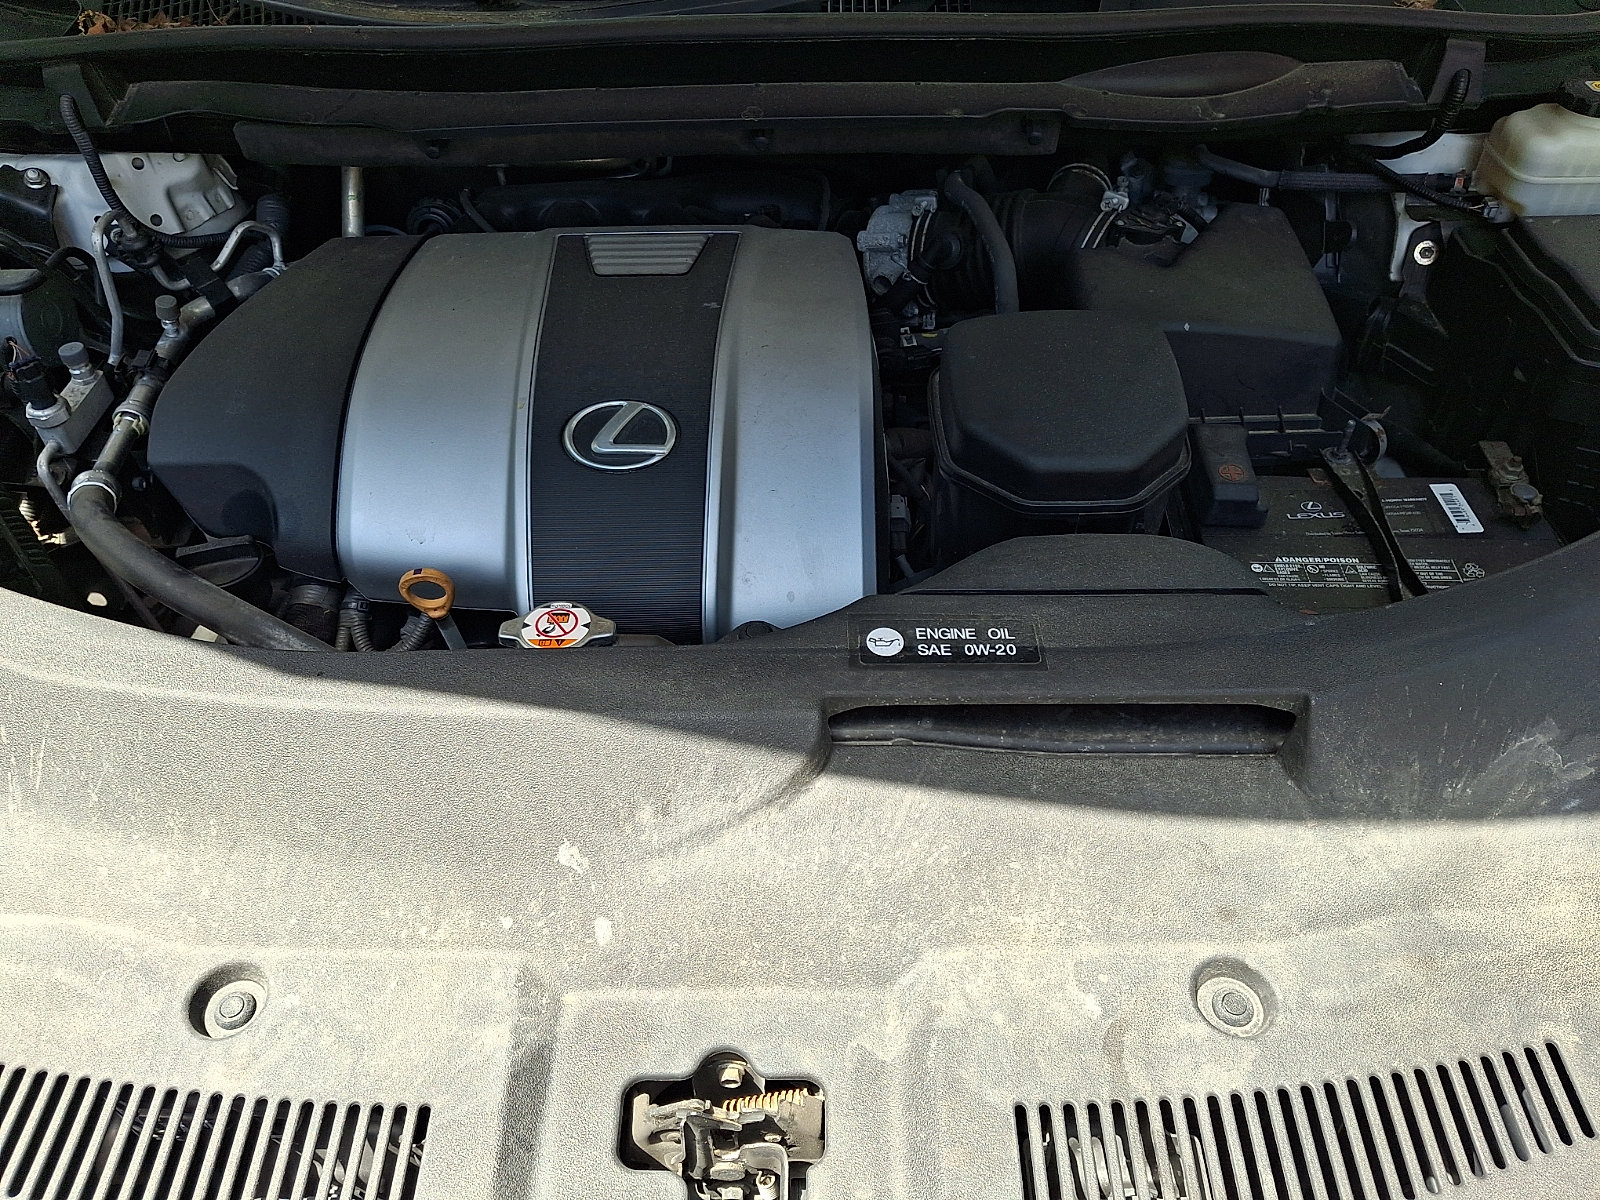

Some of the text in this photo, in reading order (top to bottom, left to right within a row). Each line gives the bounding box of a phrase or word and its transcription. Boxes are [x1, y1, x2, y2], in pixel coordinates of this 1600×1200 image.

[915, 628, 1016, 640] ENGINE OIL
[918, 644, 1017, 656] SAE 0W-20
